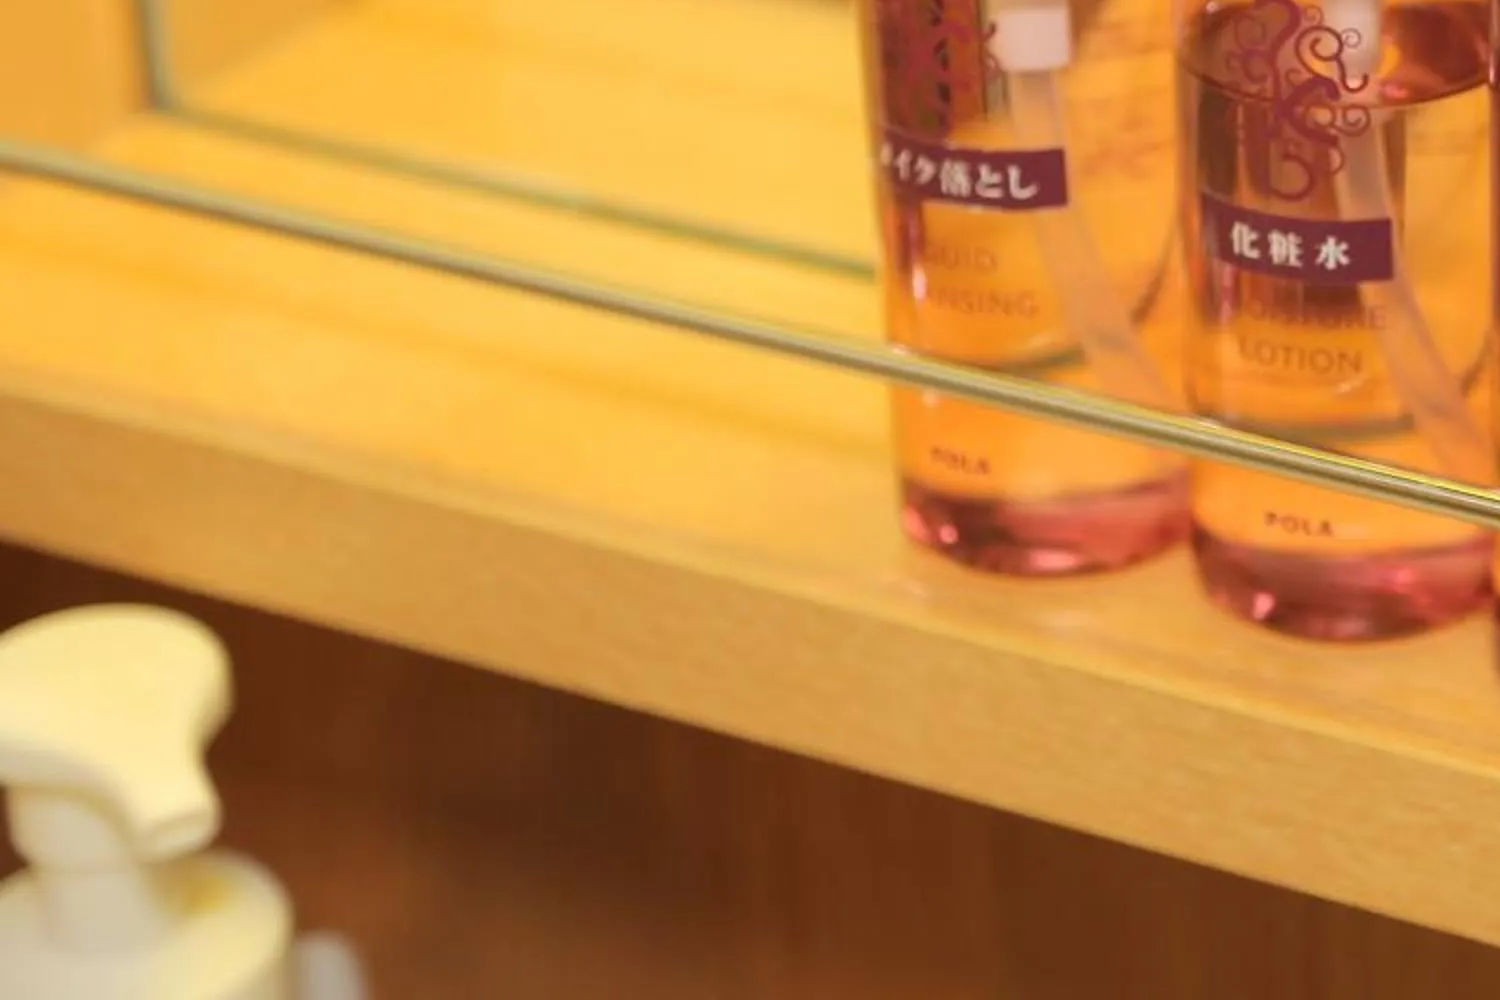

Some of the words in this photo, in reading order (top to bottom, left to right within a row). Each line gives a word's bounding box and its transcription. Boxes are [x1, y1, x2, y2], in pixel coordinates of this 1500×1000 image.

[1231, 221, 1352, 270] 化粧水
[1237, 333, 1364, 376] LOTION
[1263, 510, 1335, 537] POLA
